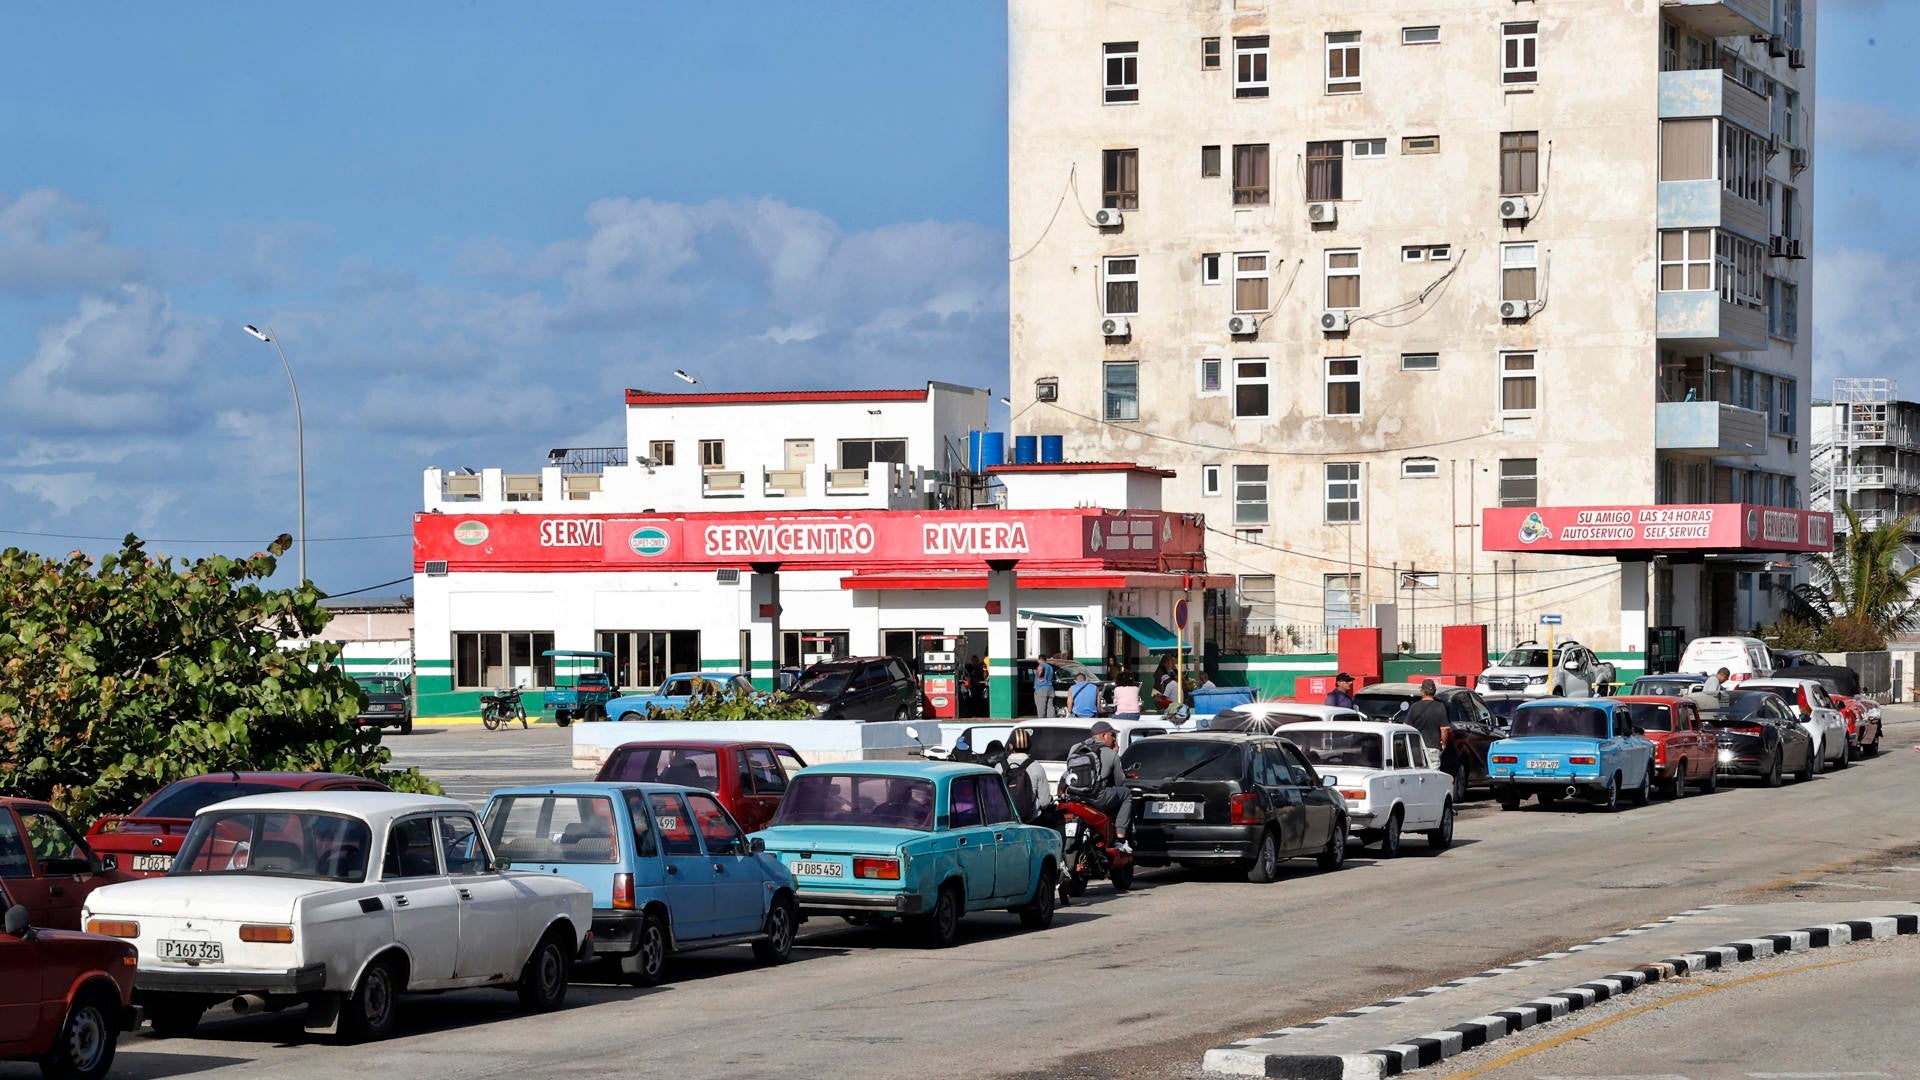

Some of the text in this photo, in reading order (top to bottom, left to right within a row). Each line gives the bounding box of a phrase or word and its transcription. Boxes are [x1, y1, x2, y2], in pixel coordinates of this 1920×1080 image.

[1578, 510, 1712, 524] SU AMIGO LAS 24 HORAS
[705, 525, 874, 553] SERVICENTRO
[924, 524, 1028, 552] RIVIERA
[1645, 527, 1666, 538] SELF
[1668, 526, 1708, 538] SERVICE
